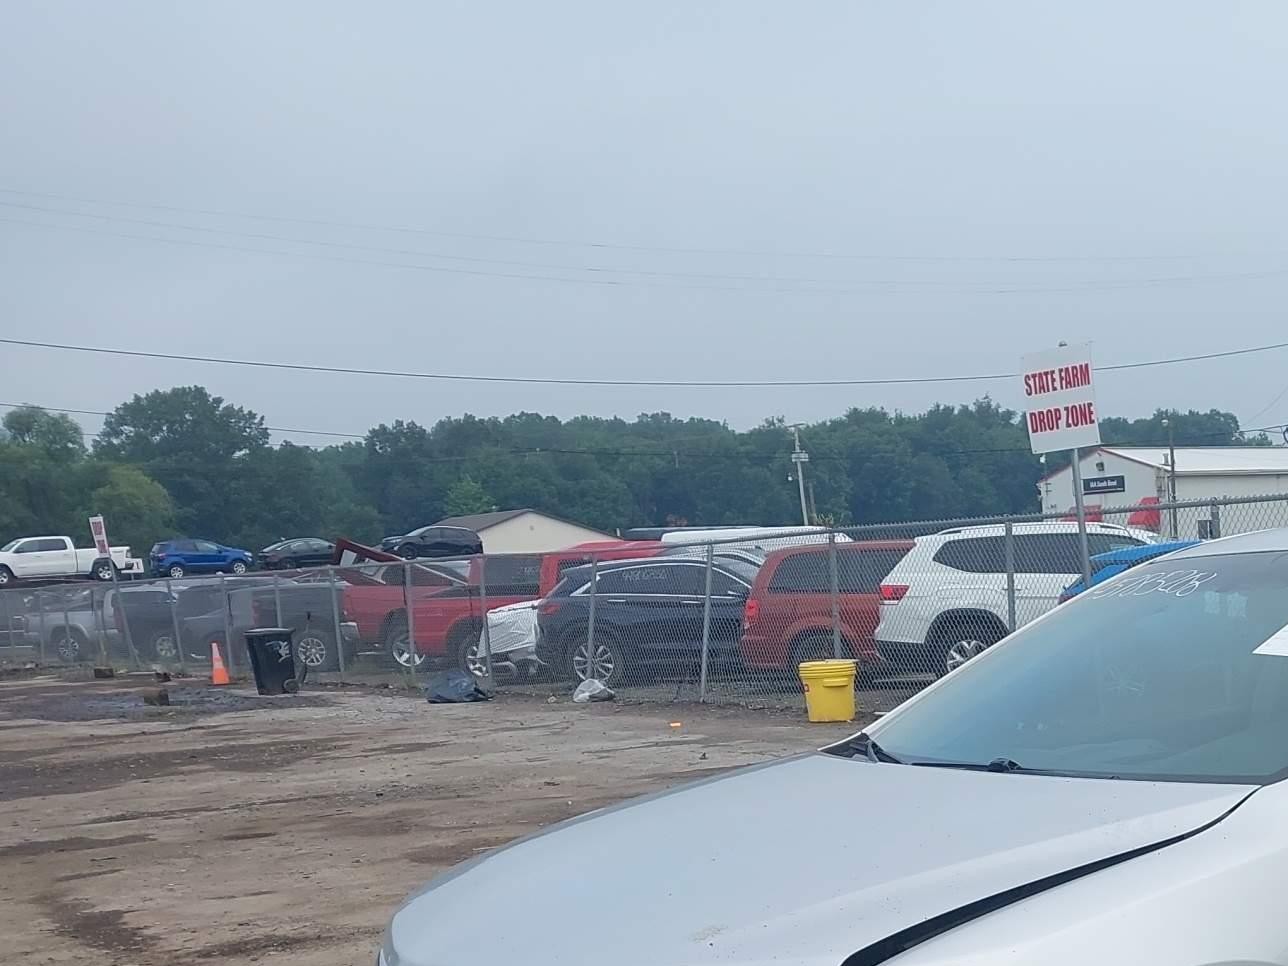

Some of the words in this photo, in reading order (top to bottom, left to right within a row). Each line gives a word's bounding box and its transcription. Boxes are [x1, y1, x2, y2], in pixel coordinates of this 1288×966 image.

[1024, 370, 1058, 397] STATE
[1058, 363, 1091, 390] FARM
[1029, 407, 1062, 434] DROP
[1064, 402, 1095, 428] ZONE
